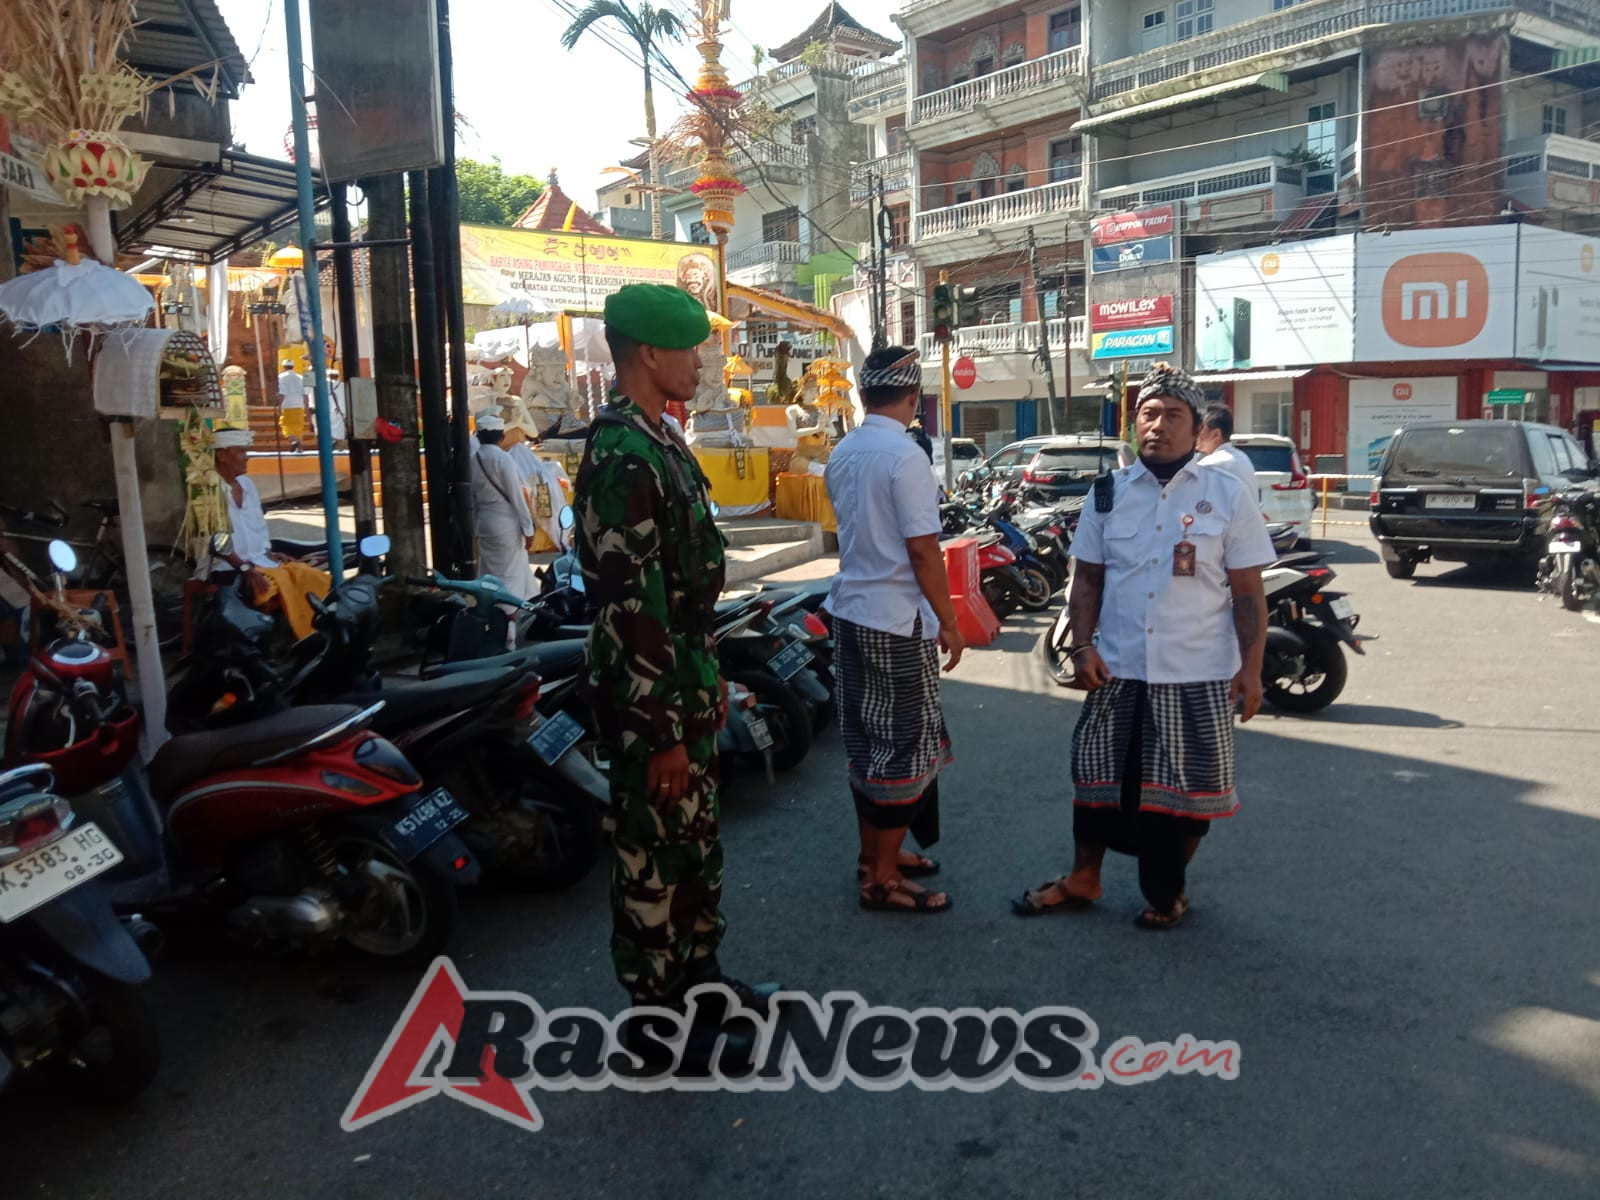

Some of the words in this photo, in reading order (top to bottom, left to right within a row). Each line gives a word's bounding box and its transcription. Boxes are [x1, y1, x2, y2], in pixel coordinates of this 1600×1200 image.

[0, 156, 35, 190] SARI
[1144, 214, 1169, 227] PAINT
[1105, 334, 1157, 349] PARAGON
[73, 828, 103, 852] HG
